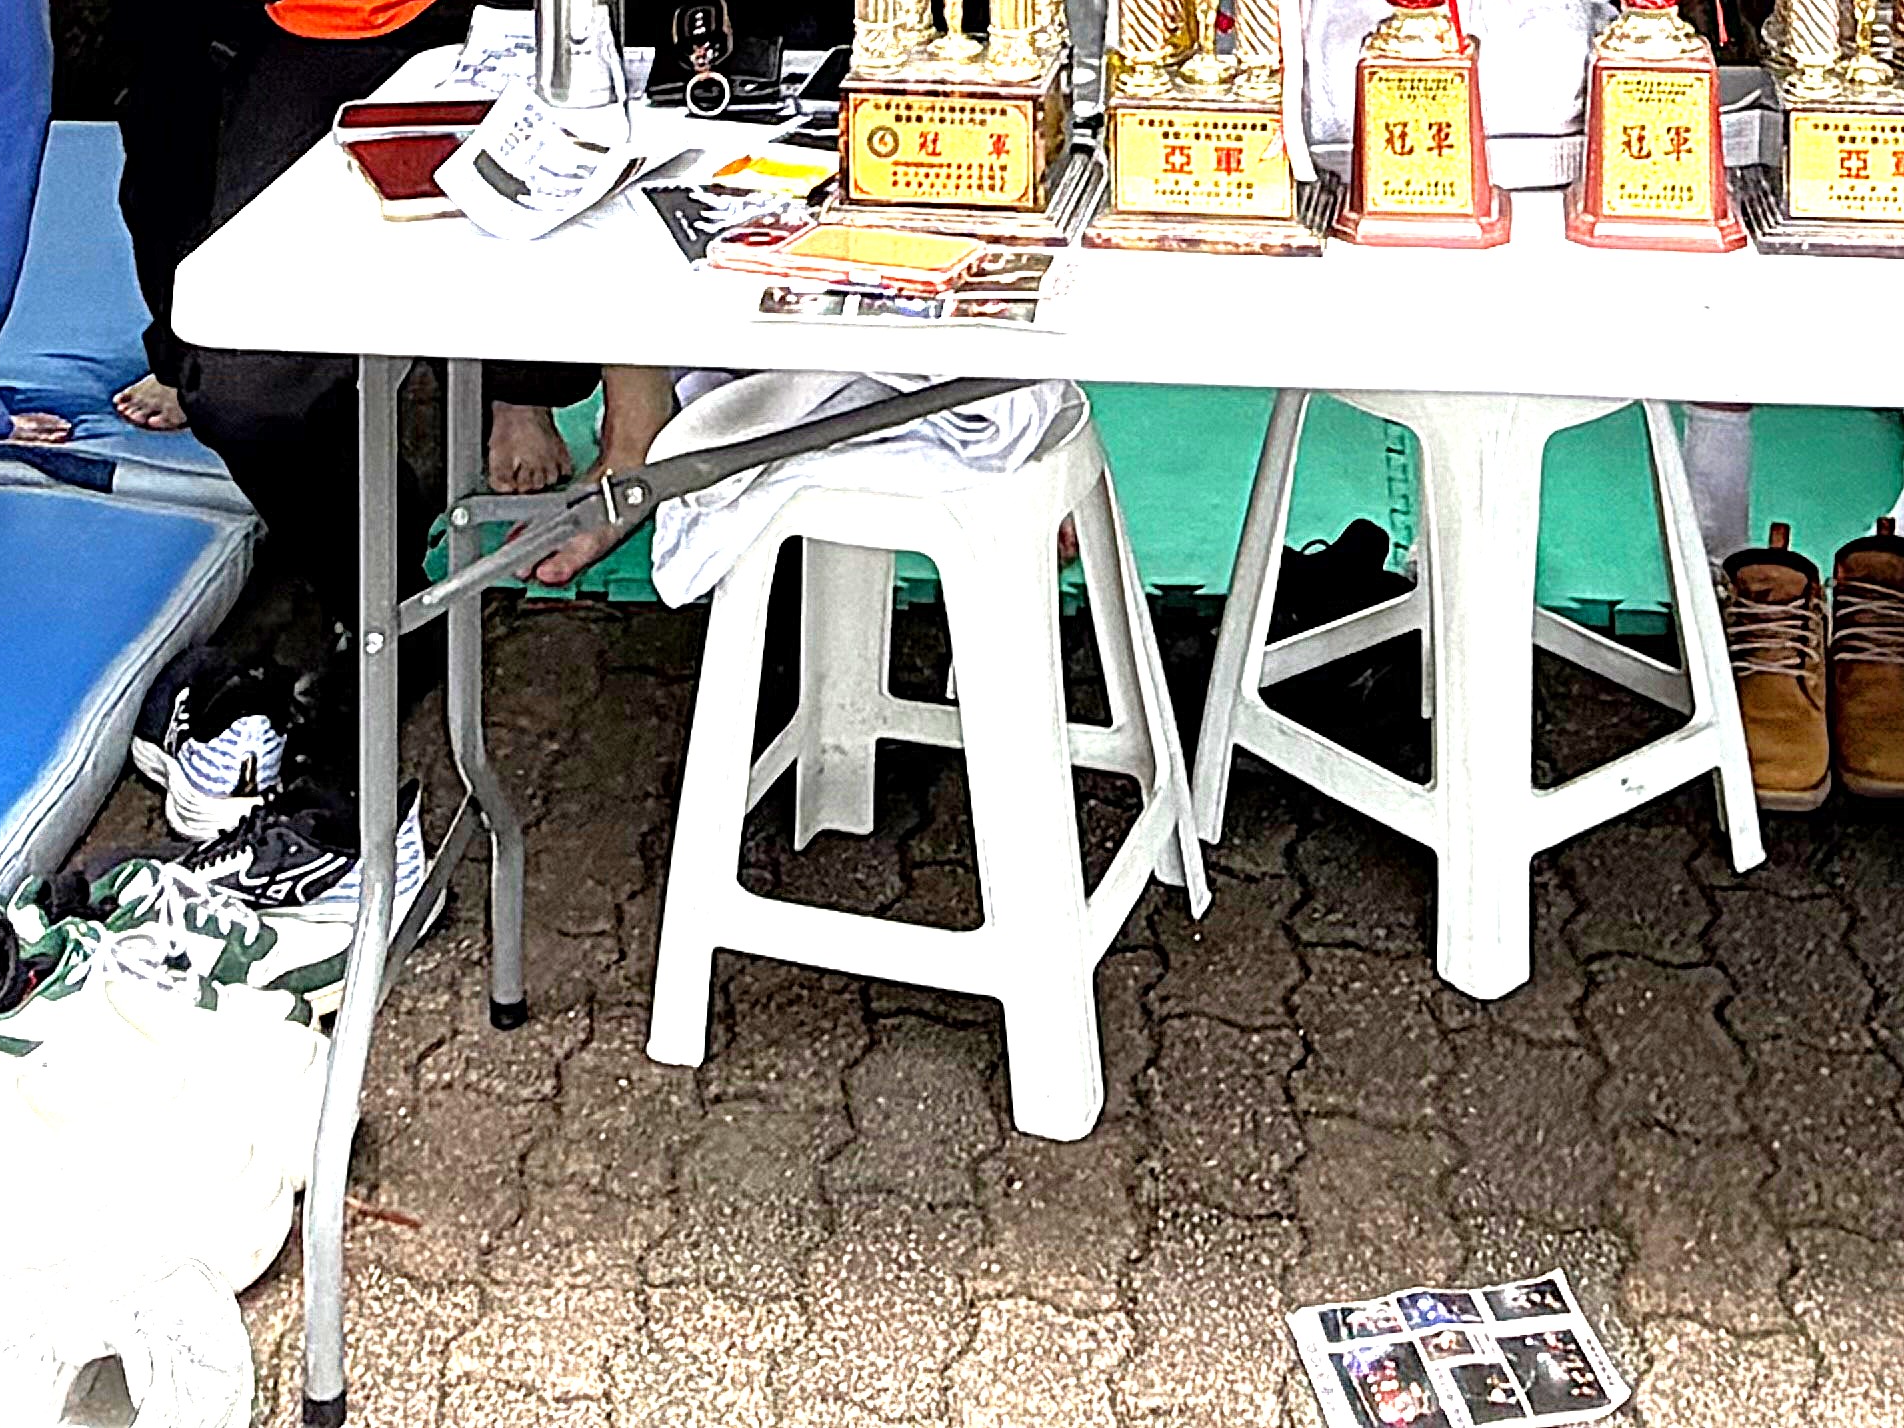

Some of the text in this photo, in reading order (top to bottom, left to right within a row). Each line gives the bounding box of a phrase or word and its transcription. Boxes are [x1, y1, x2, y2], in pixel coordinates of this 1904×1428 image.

[1384, 121, 1454, 157] 冠軍
[1621, 125, 1694, 162] 冠軍
[1162, 145, 1245, 176] 亞軍
